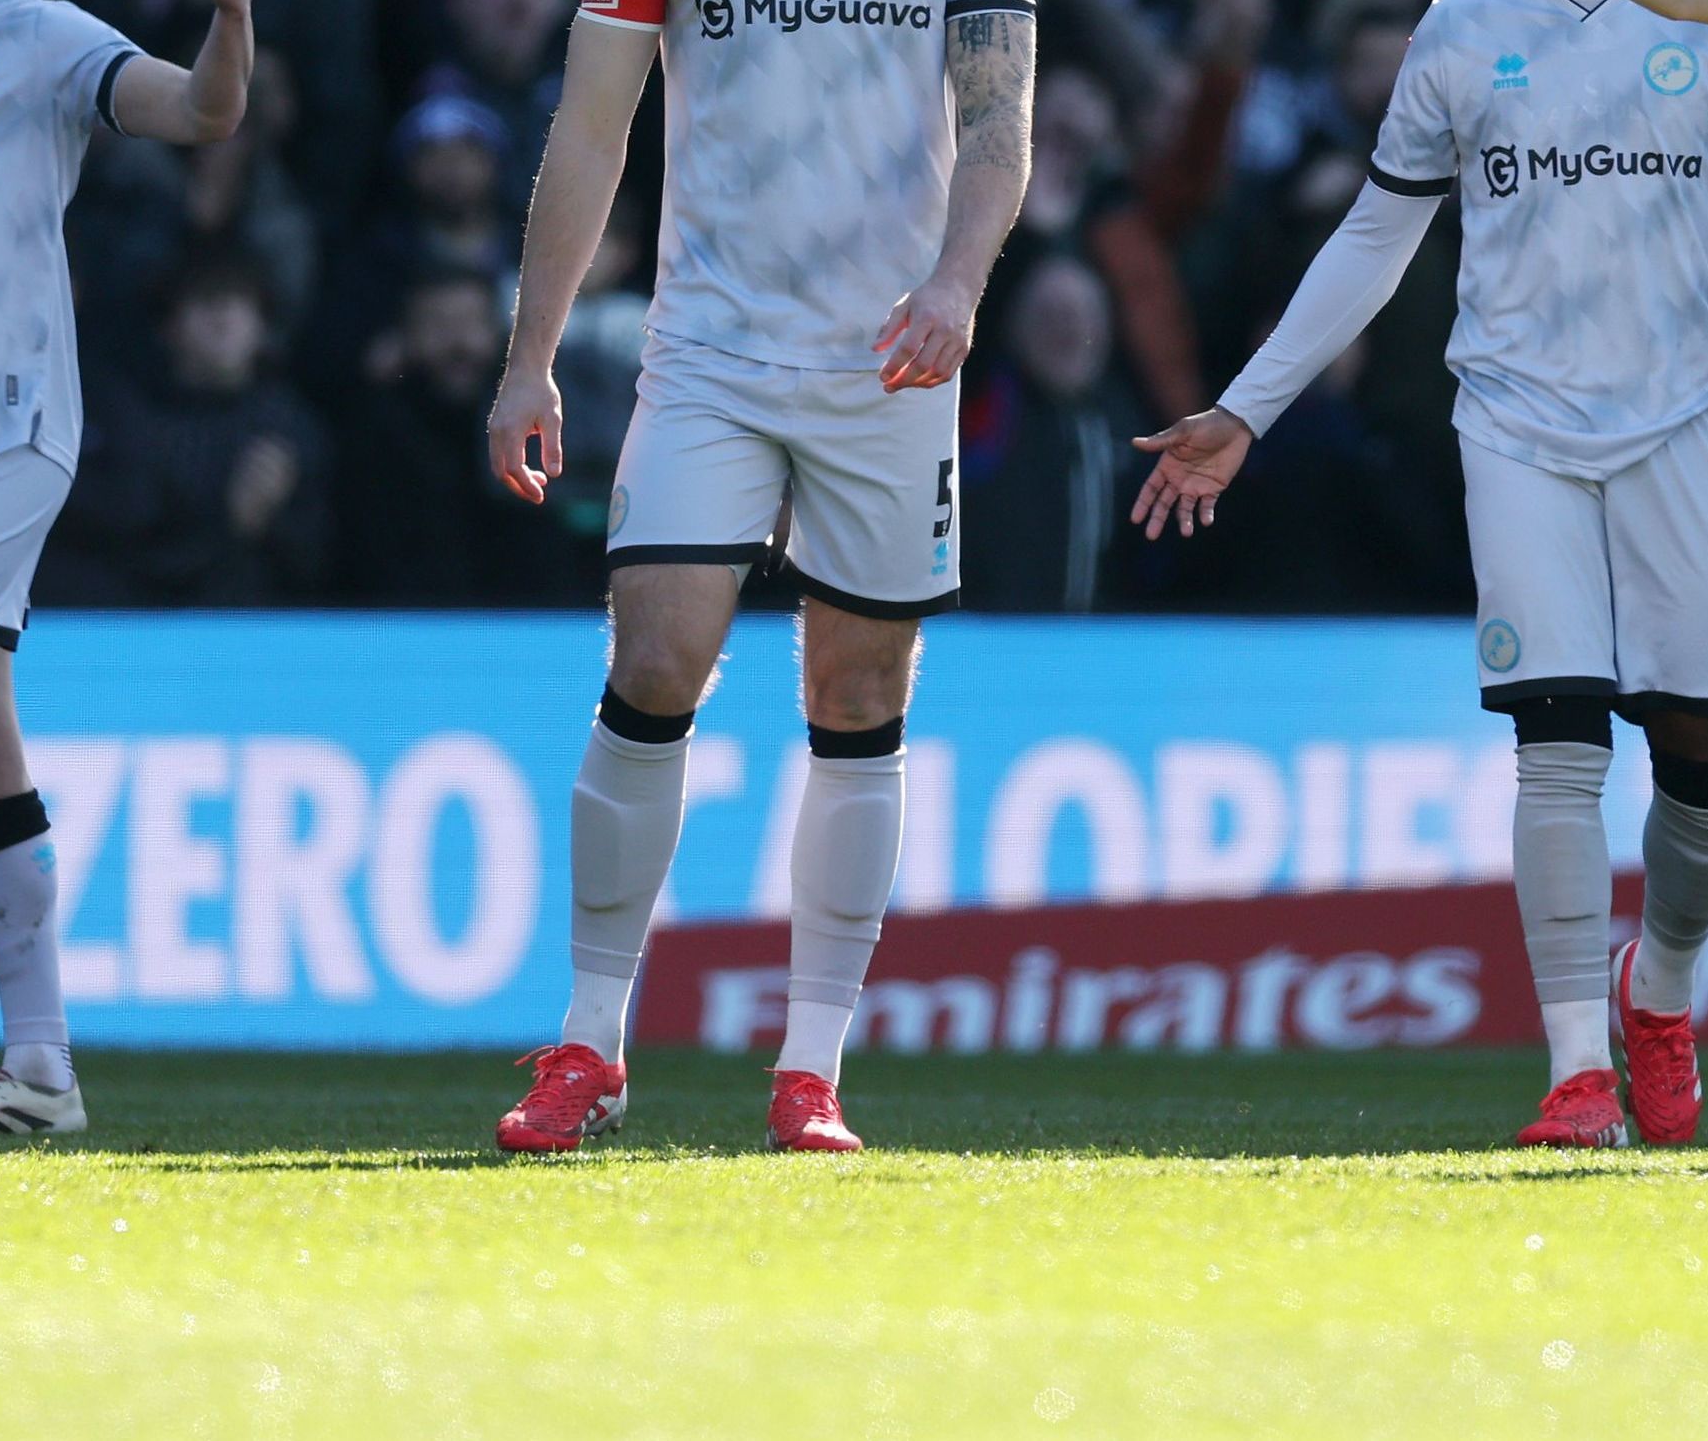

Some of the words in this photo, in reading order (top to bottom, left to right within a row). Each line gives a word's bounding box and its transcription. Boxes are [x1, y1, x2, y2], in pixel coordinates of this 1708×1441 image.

[1527, 144, 1702, 186] MyGuava
[933, 457, 953, 538] 5
[700, 946, 1483, 1056] Emirates
